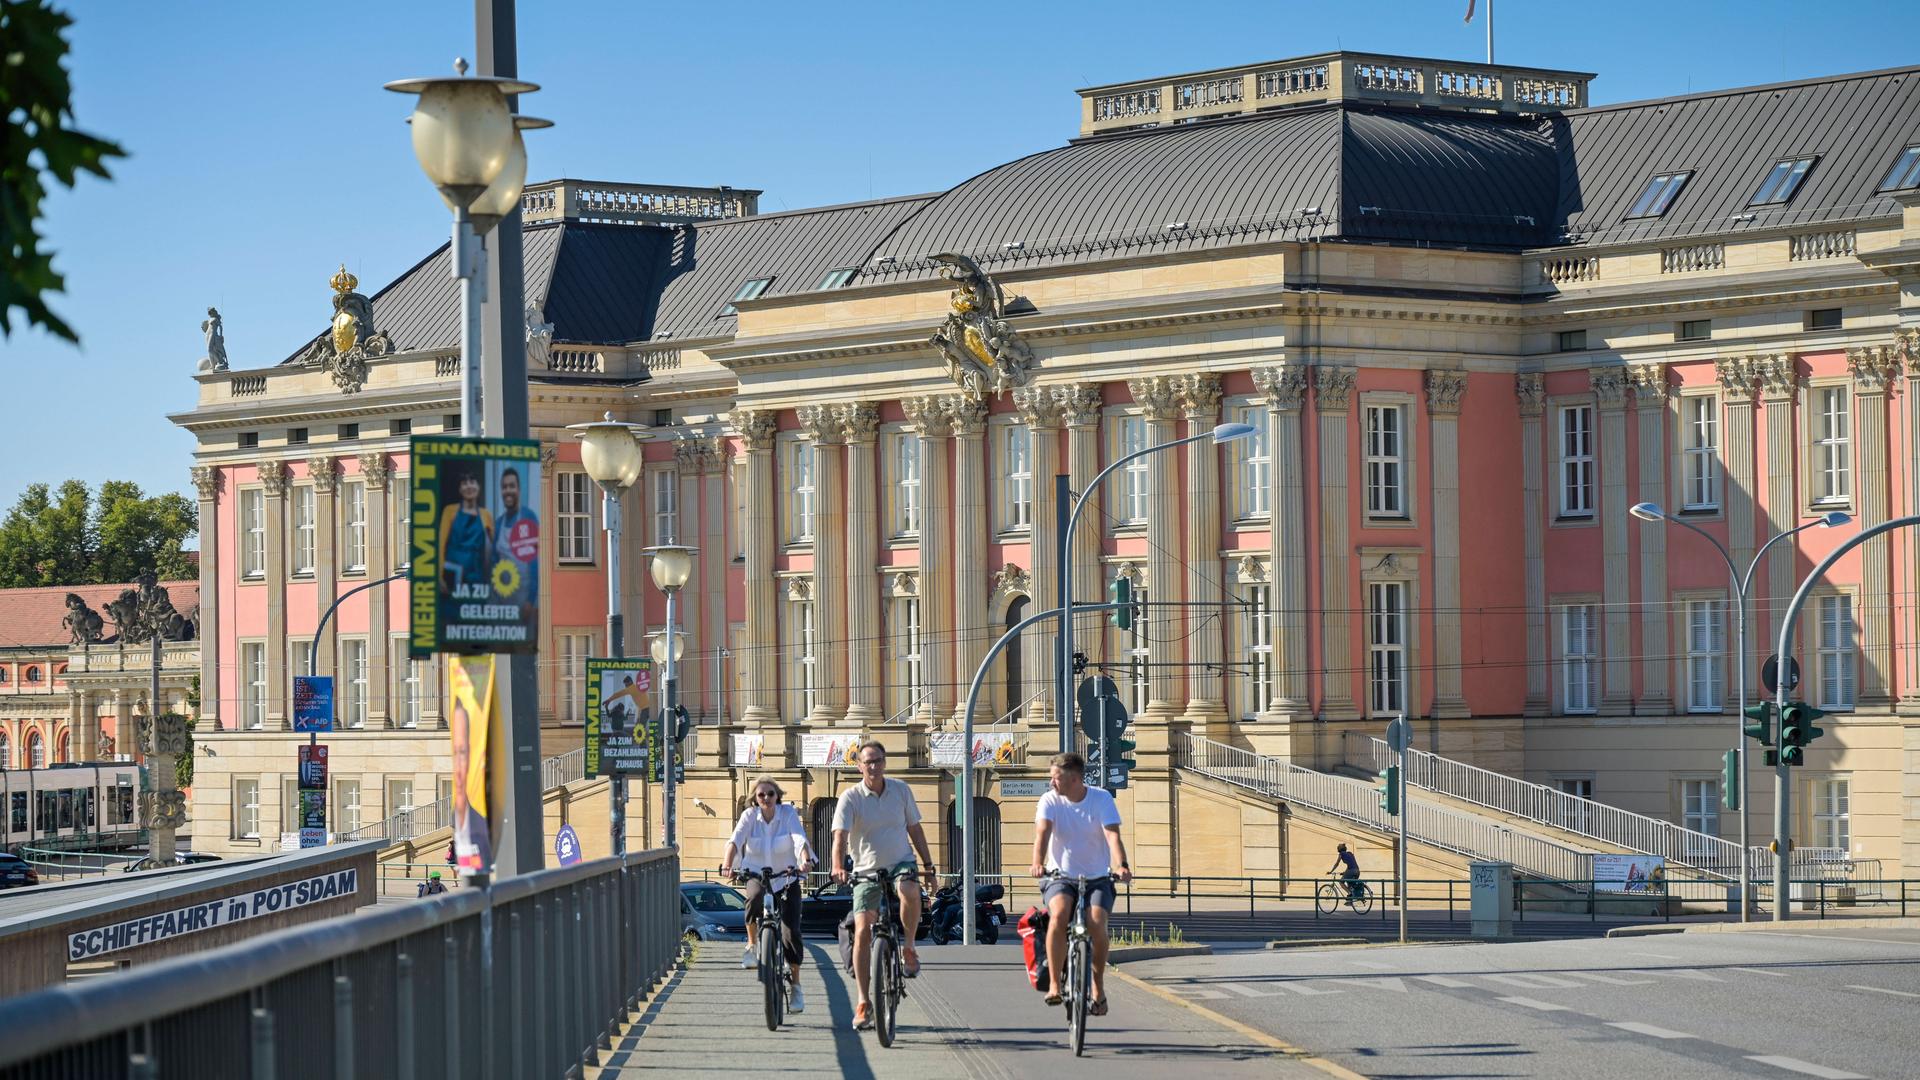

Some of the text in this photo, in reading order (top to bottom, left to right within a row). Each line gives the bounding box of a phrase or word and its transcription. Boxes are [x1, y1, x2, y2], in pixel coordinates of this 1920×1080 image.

[414, 442, 539, 459] EINANDER
[414, 455, 437, 648] MEHR MUT
[452, 583, 490, 598] JA ZU
[460, 604, 520, 620] GELEBTER
[446, 624, 526, 641] INTEGRATION
[588, 661, 650, 669] EINANDER
[587, 669, 600, 773] MEHR MUT
[607, 737, 633, 746] JA ZUM
[616, 760, 643, 769] ZUHAUSE
[71, 870, 356, 959] SCHIFFFAHRT in POTSDAM
